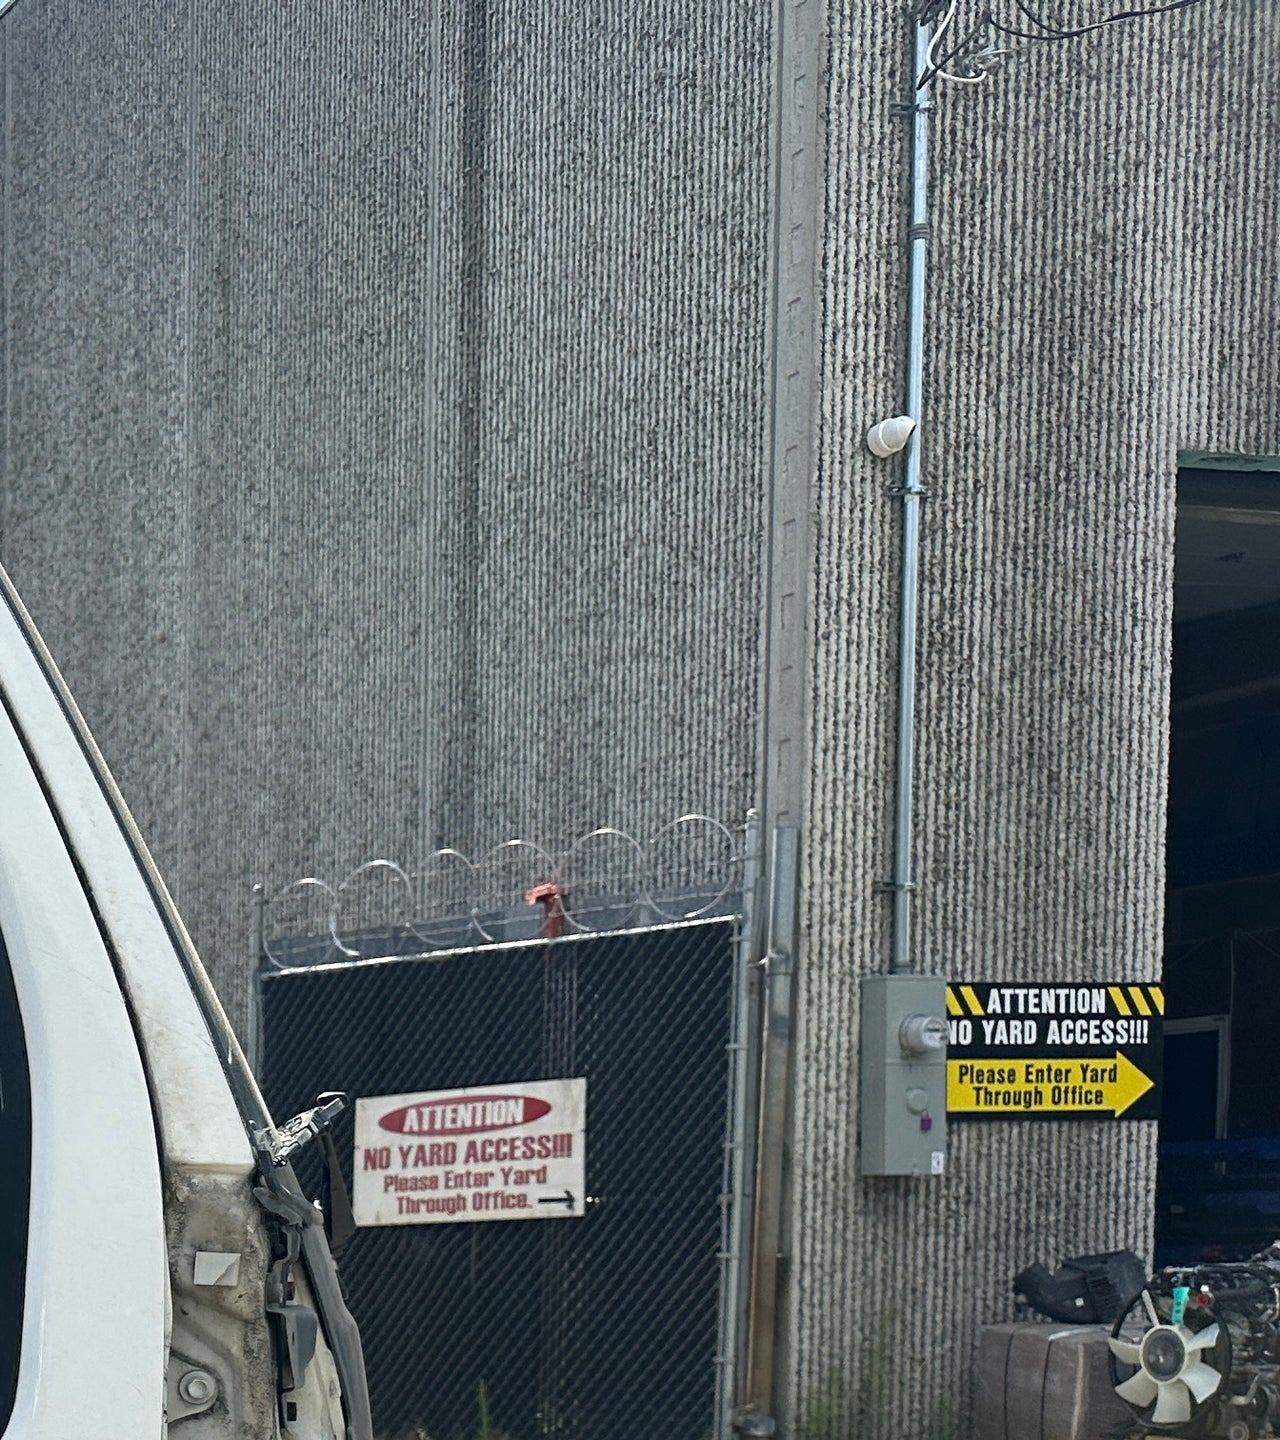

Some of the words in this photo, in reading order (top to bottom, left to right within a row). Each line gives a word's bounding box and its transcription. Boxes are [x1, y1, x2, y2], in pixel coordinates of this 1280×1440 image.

[987, 988, 1106, 1015] ATTENTION
[947, 1020, 973, 1046] NO
[982, 1019, 1038, 1046] YARD
[1046, 1019, 1149, 1045] ACCESS!!!
[958, 1064, 1016, 1084] Please
[1024, 1064, 1072, 1084] Enter
[1079, 1063, 1118, 1083] Yard
[972, 1086, 1043, 1109] Through
[1051, 1086, 1104, 1105] Office
[402, 1099, 524, 1132] ATTENTION
[363, 1146, 391, 1171] NO
[398, 1140, 457, 1169] YARD
[463, 1133, 573, 1165] ACCESS!!!
[383, 1174, 439, 1193] Please
[444, 1170, 494, 1189] Enter
[500, 1165, 547, 1185] Yard
[397, 1194, 467, 1216] Through
